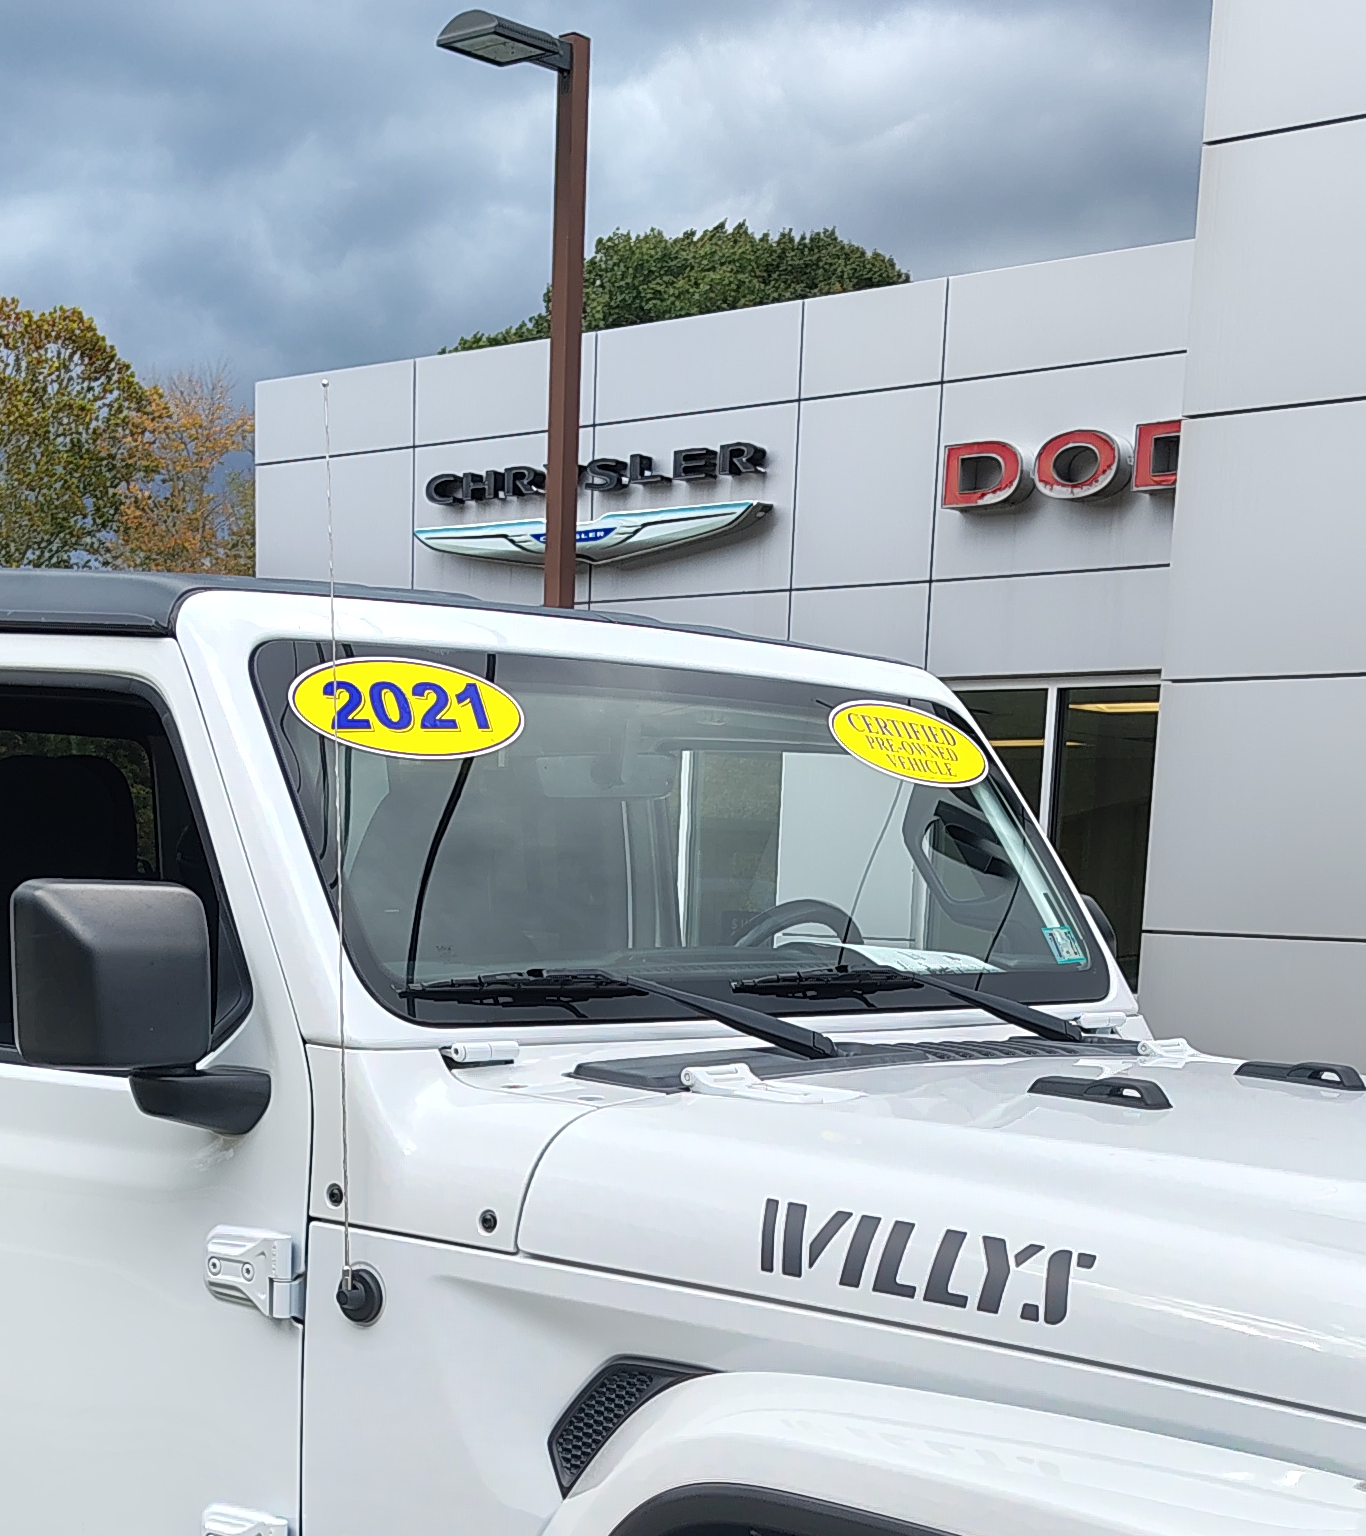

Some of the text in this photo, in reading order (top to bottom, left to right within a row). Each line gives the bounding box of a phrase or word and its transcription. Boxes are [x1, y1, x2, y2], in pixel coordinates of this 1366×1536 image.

[425, 442, 767, 505] CHRSLER
[322, 681, 492, 732] 2021
[847, 712, 957, 747] CERTIFIED
[865, 735, 959, 762] PRE-OWNED
[886, 753, 958, 778] VEHICLE
[761, 1197, 1097, 1325] WILLYS
